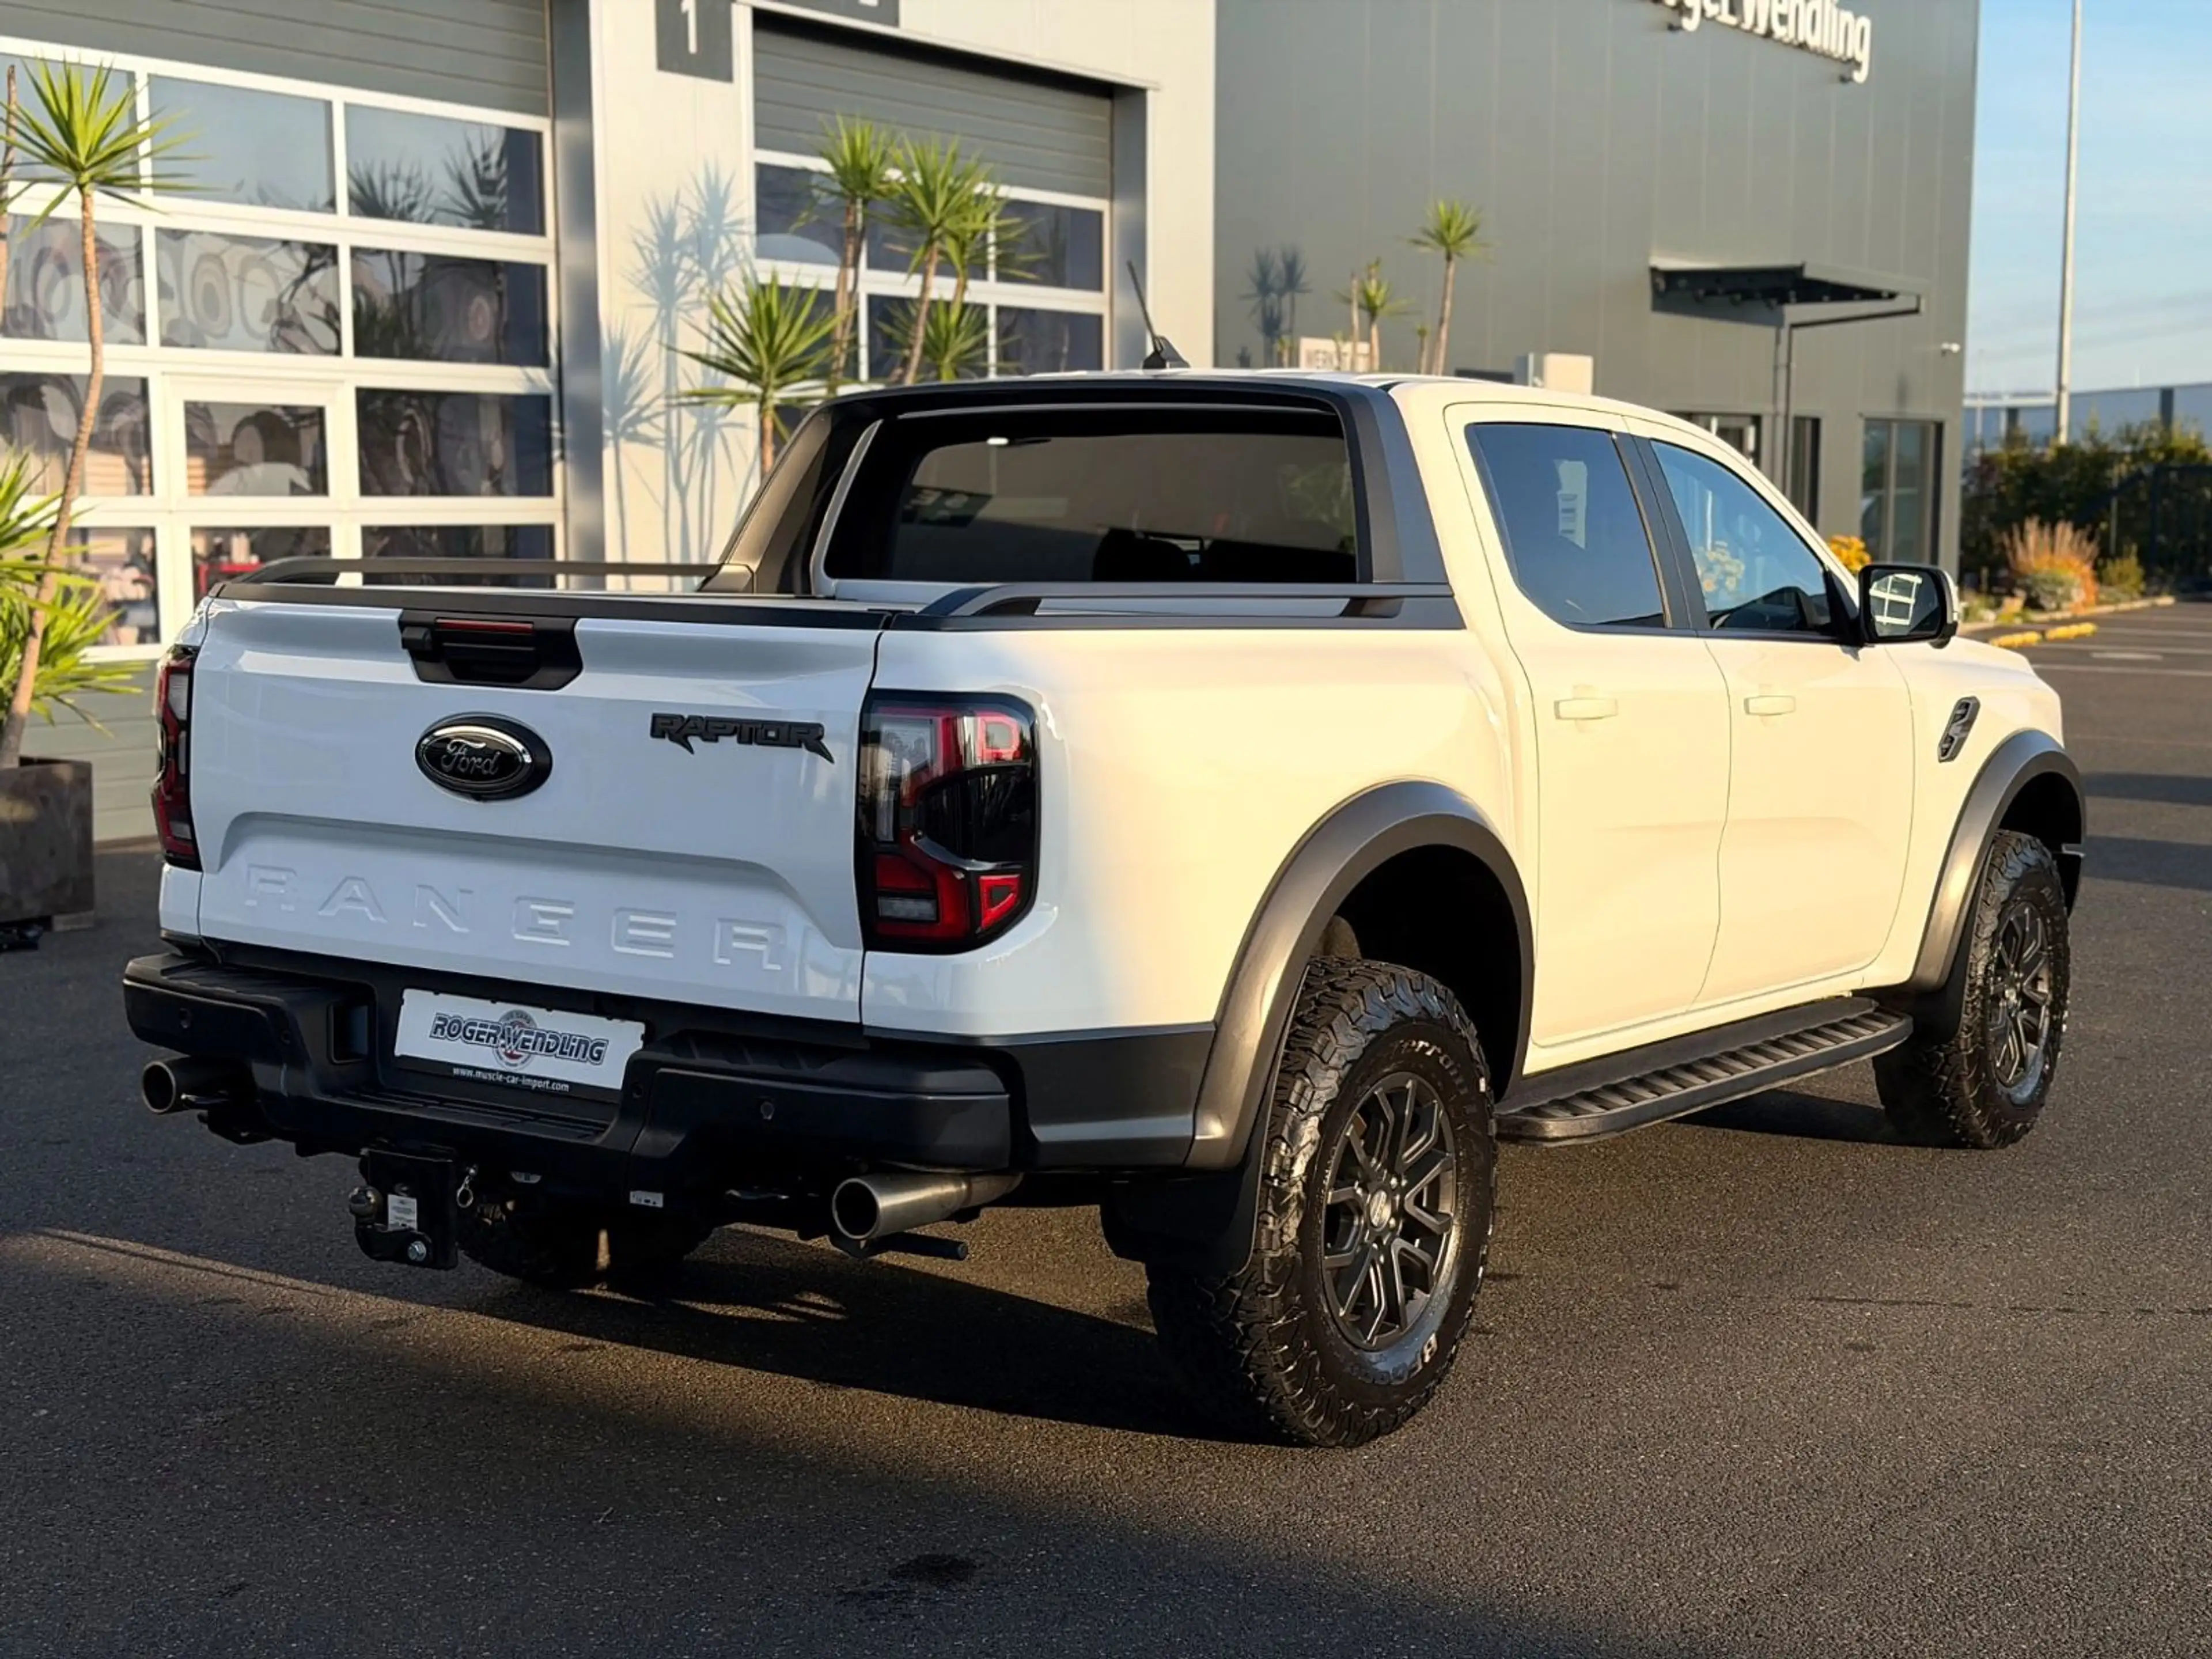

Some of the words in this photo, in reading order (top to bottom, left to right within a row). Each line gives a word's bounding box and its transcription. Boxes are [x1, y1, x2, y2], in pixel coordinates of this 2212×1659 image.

[680, 0, 697, 55] 1
[1740, 0, 1871, 83] Wendling
[441, 739, 502, 775] Ford
[650, 713, 835, 764] RAPTOR
[245, 863, 787, 971] RANGER
[452, 1067, 570, 1093] www.muscle-car-import.com
